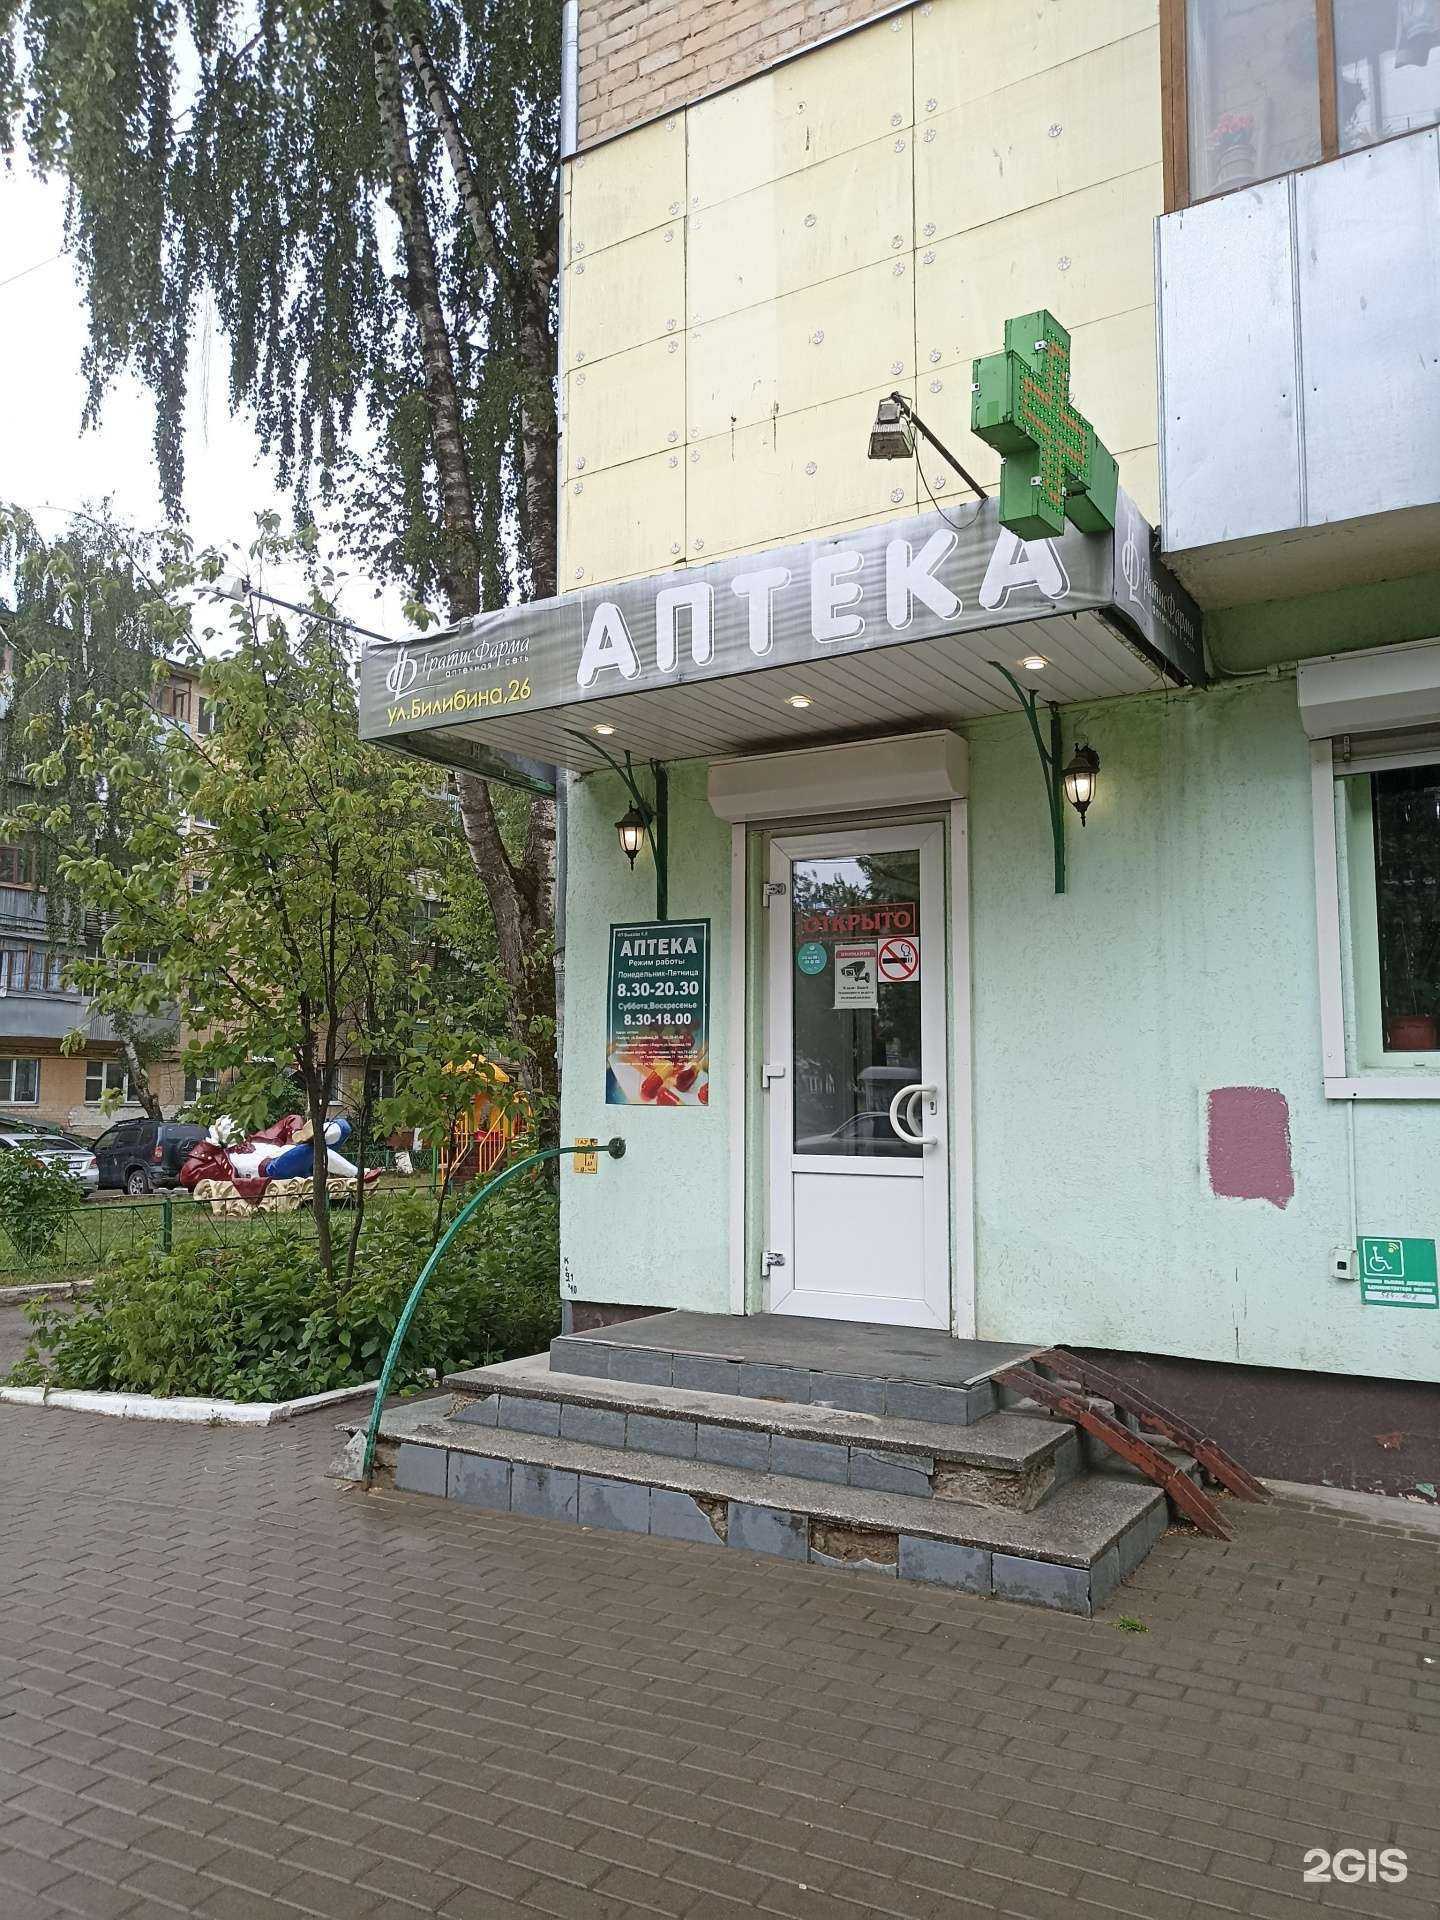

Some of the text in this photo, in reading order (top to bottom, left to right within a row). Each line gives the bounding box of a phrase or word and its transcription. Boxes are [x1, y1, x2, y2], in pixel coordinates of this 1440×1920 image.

[577, 526, 1071, 688] АПТЕКА
[422, 636, 530, 681] ГратисФарма
[387, 677, 532, 728] ул.Билибина,26
[620, 937, 698, 957] АПТЕКА
[628, 959, 654, 967] Режим
[617, 981, 700, 997] 8.30-20.30
[624, 1013, 692, 1026] 8.30-18.00
